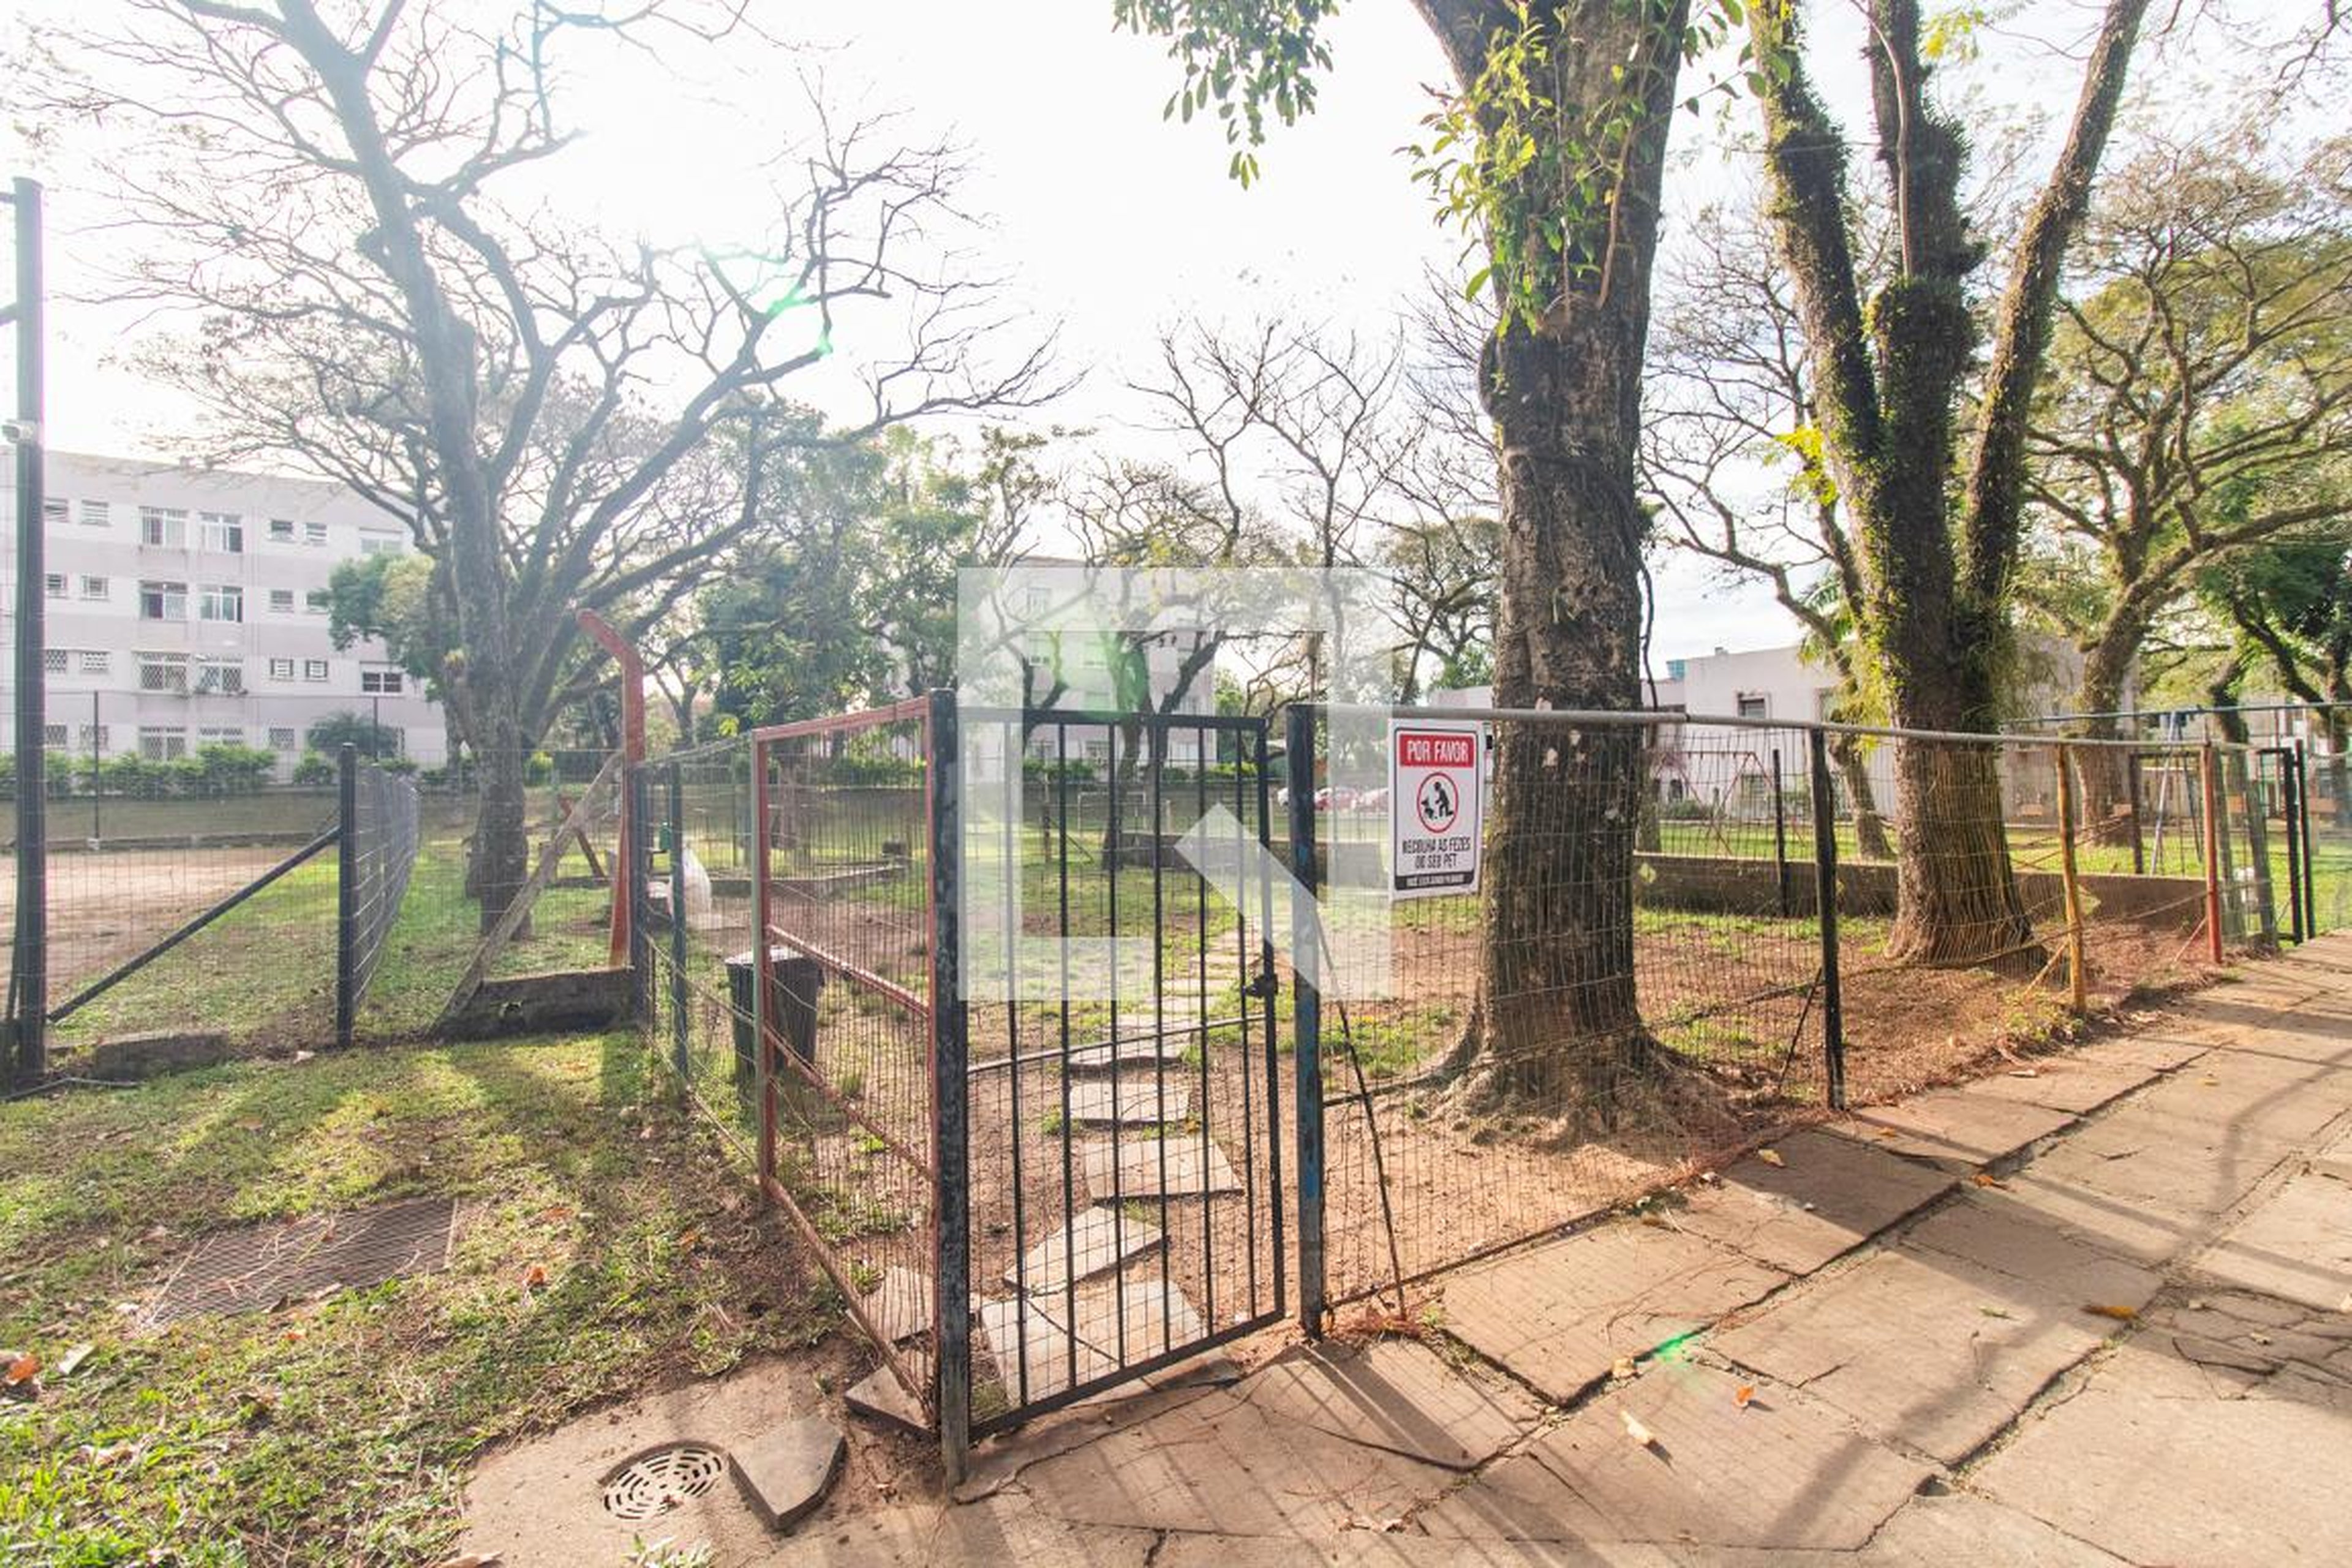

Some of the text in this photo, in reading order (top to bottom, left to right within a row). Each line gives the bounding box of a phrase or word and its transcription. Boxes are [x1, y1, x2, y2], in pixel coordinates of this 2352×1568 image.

[1408, 740, 1468, 763] POR FAVOR
[1439, 838, 1448, 852] AS
[1443, 853, 1457, 868] PET
